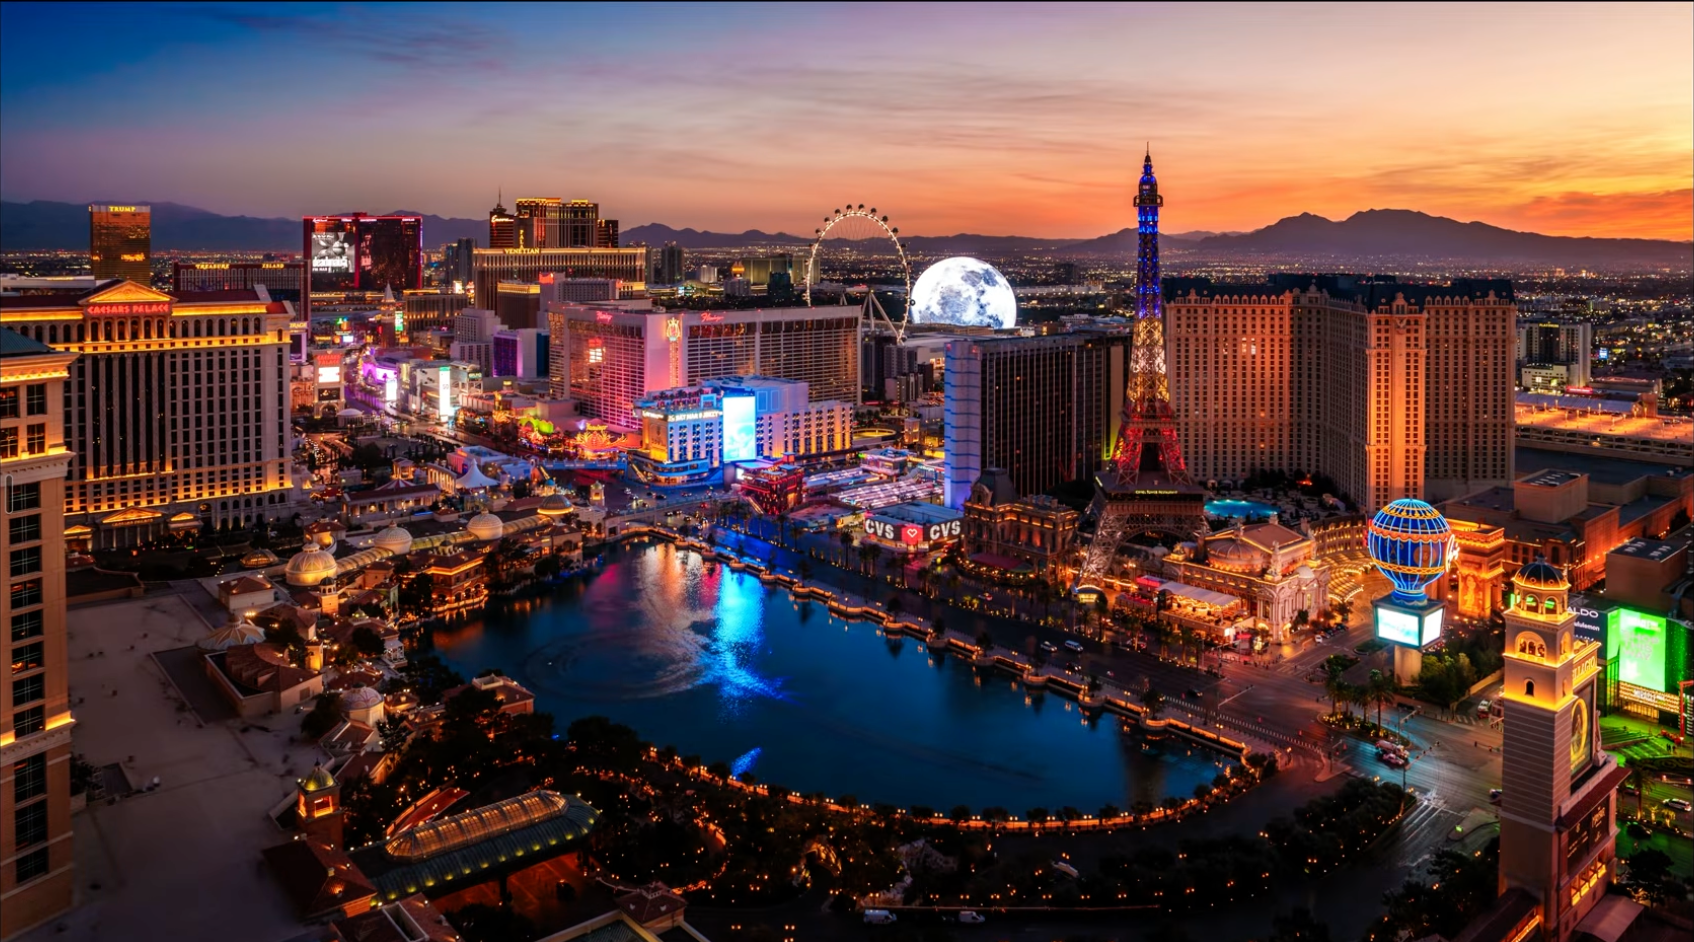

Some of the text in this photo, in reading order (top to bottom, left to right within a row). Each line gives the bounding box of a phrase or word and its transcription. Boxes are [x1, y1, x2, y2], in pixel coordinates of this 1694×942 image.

[87, 303, 169, 315] CAESARS PALACE
[865, 519, 894, 539] CVS
[929, 520, 961, 540] CVS
